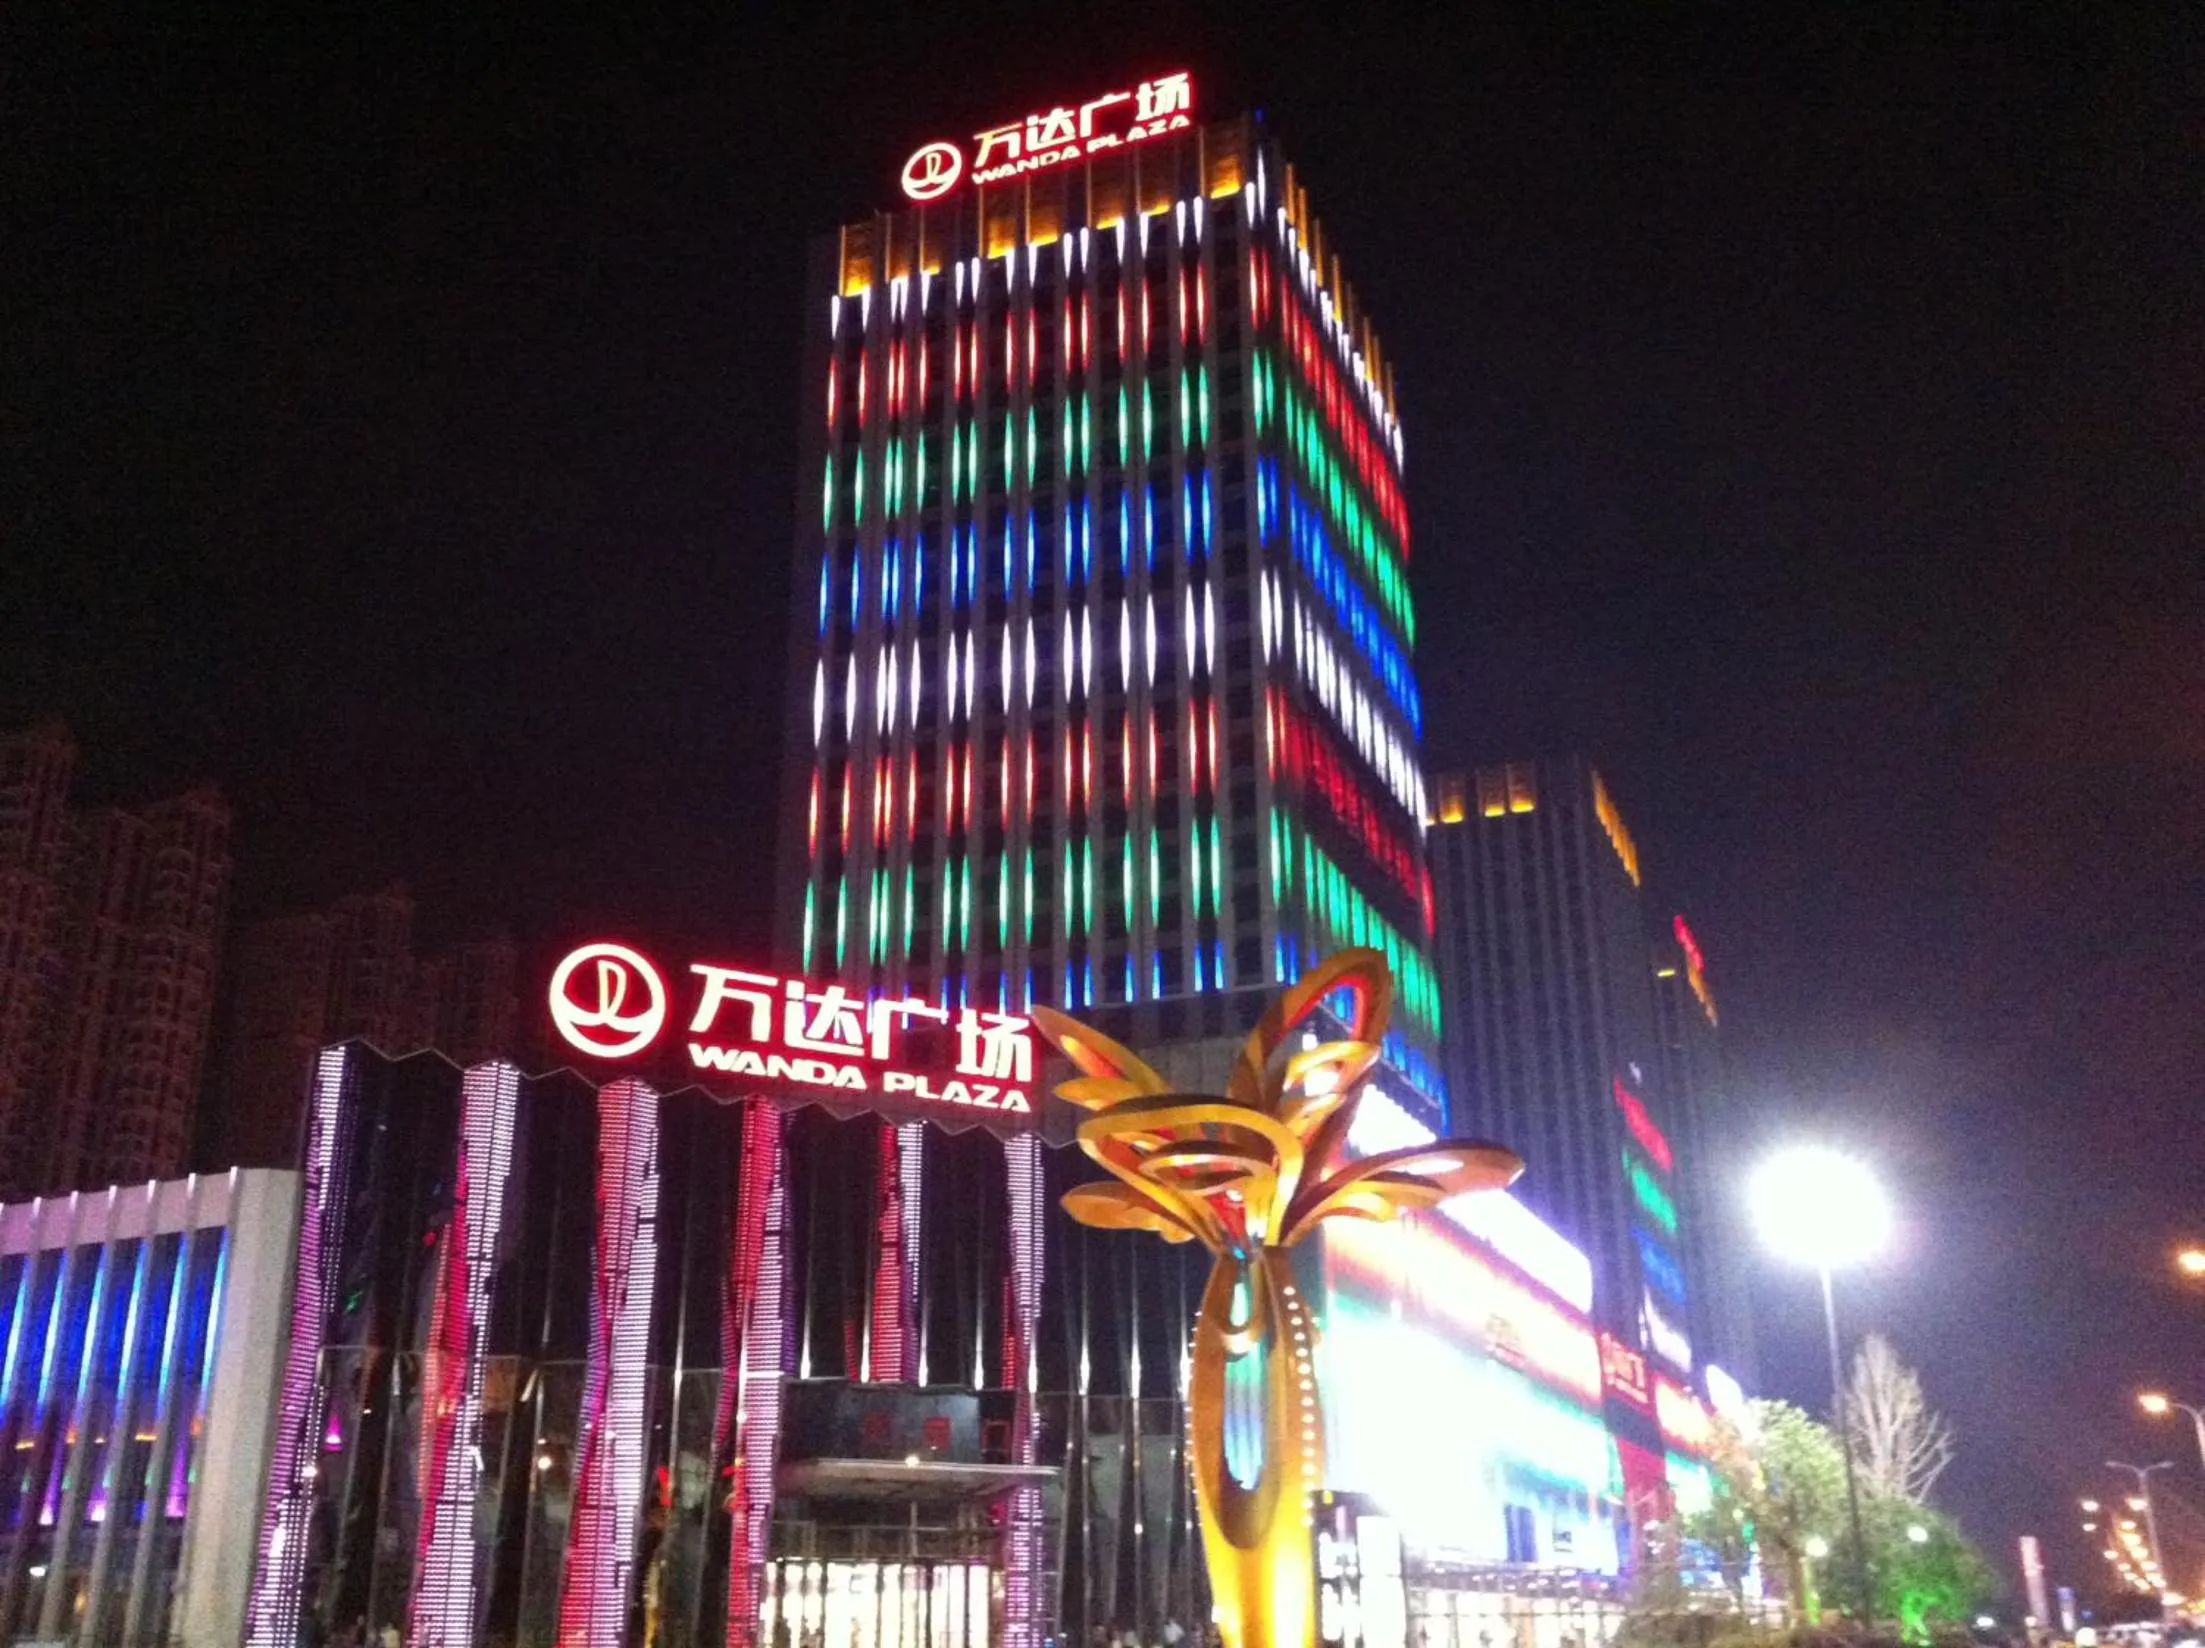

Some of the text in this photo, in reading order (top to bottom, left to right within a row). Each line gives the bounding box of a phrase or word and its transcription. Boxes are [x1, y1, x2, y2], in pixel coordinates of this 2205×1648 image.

[971, 115, 1191, 185] WANDA PLAZA
[972, 73, 1191, 168] 万达广场
[690, 964, 1033, 1083] 万达广场
[688, 1043, 1032, 1114] WANDA PLAZA
